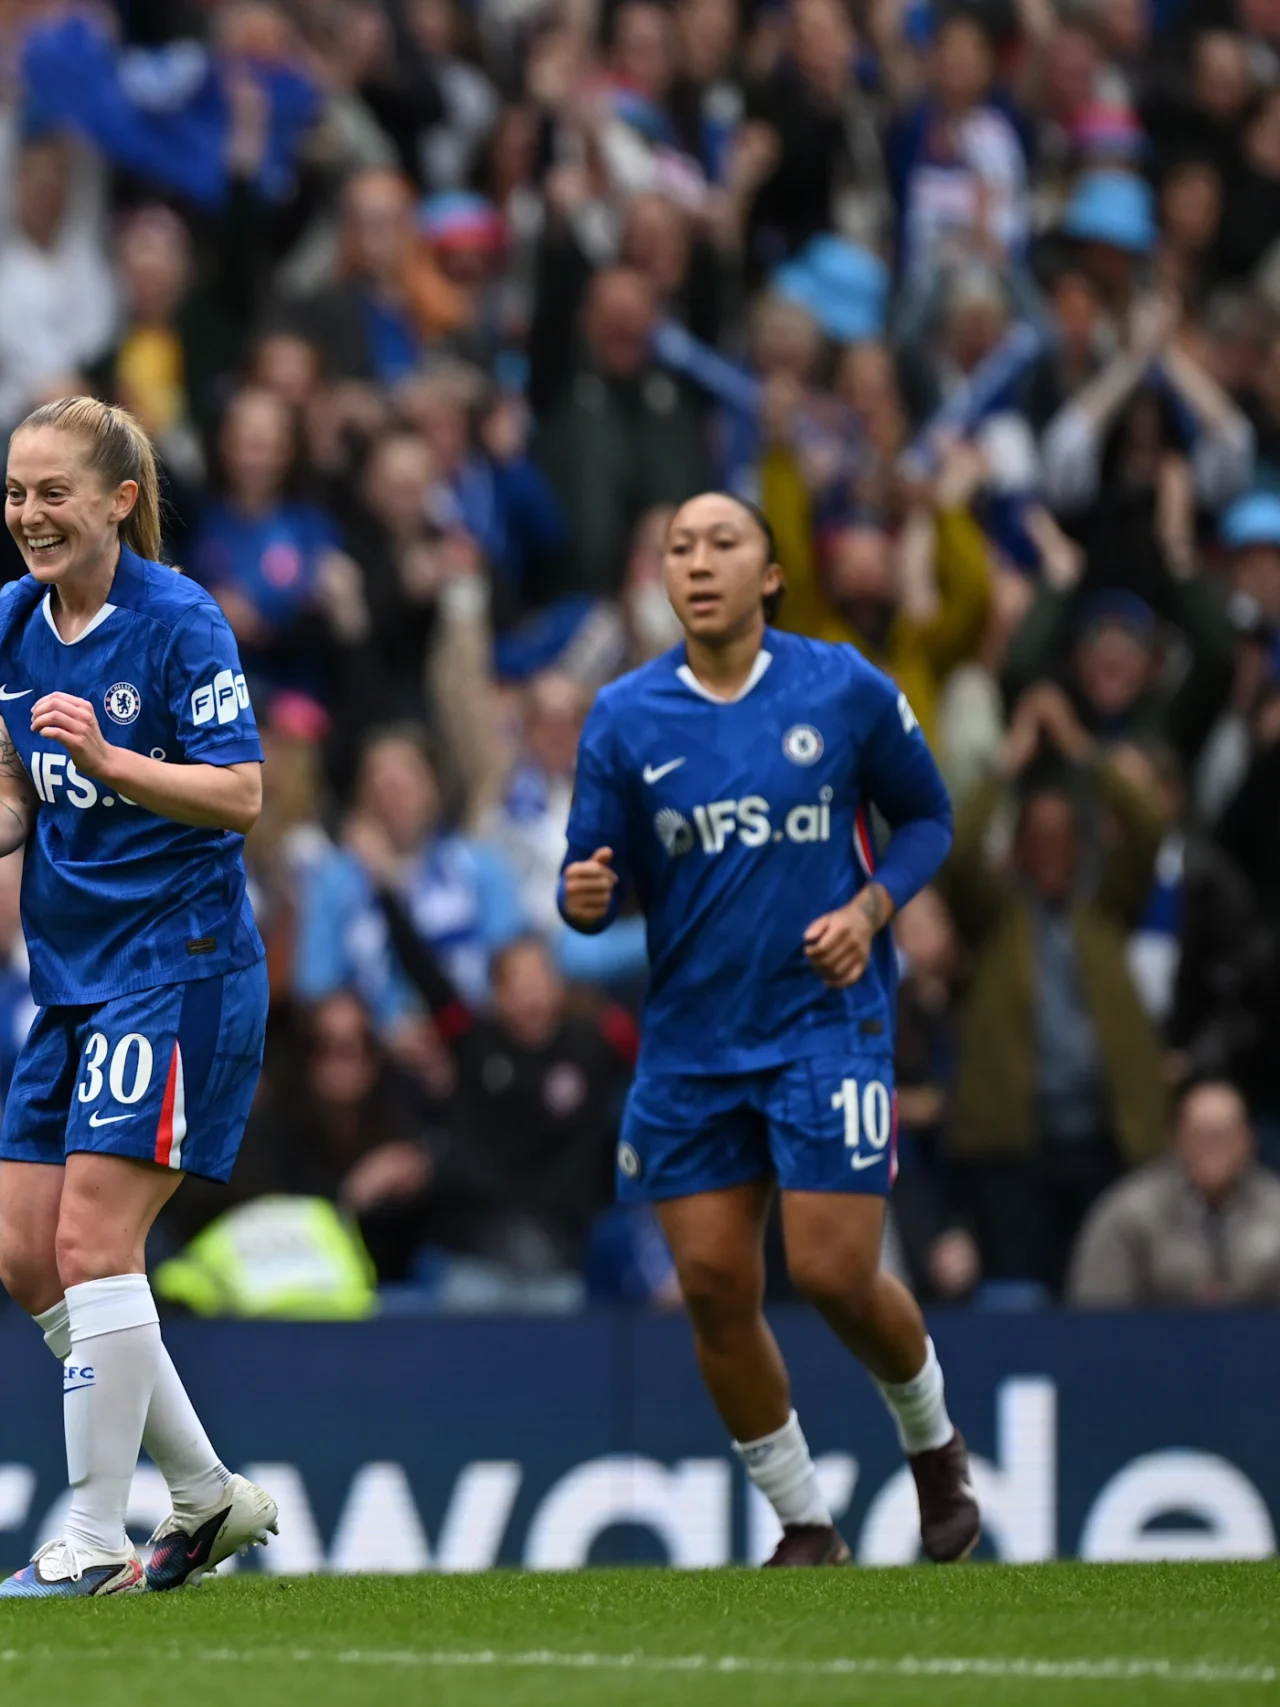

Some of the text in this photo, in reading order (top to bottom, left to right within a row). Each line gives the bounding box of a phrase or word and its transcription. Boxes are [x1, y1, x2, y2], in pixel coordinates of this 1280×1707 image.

[194, 681, 246, 717] FPT
[692, 785, 833, 856] IFS.ai
[78, 1032, 154, 1105] 30
[831, 1078, 891, 1150] 10
